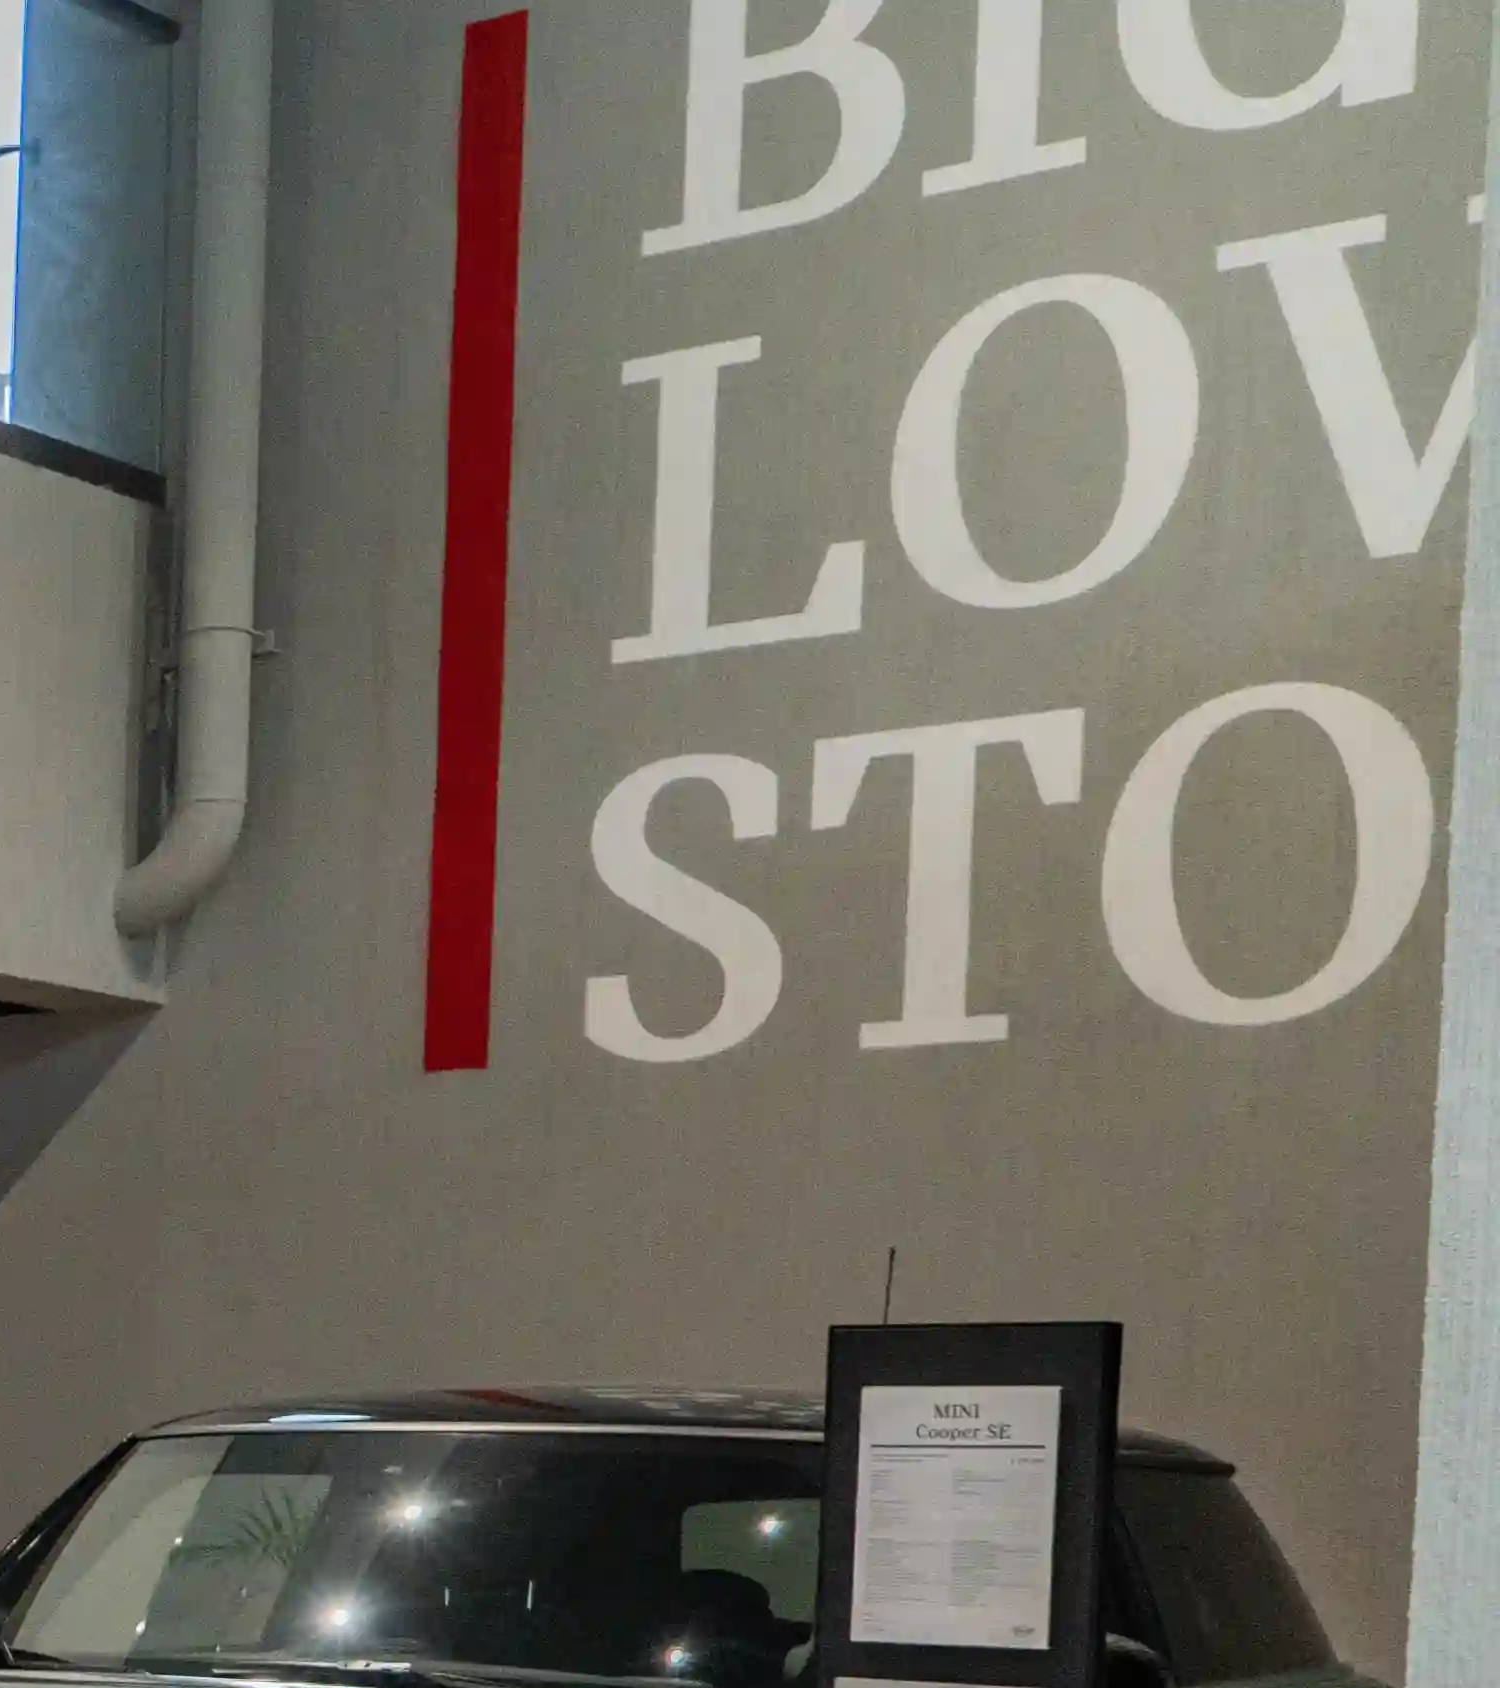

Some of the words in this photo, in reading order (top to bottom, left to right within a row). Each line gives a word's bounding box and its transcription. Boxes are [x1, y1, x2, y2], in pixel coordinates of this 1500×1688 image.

[583, 680, 1435, 1064] STO
[933, 1403, 980, 1419] MINI
[916, 1423, 981, 1441] Cooper
[986, 1423, 1012, 1440] SE
